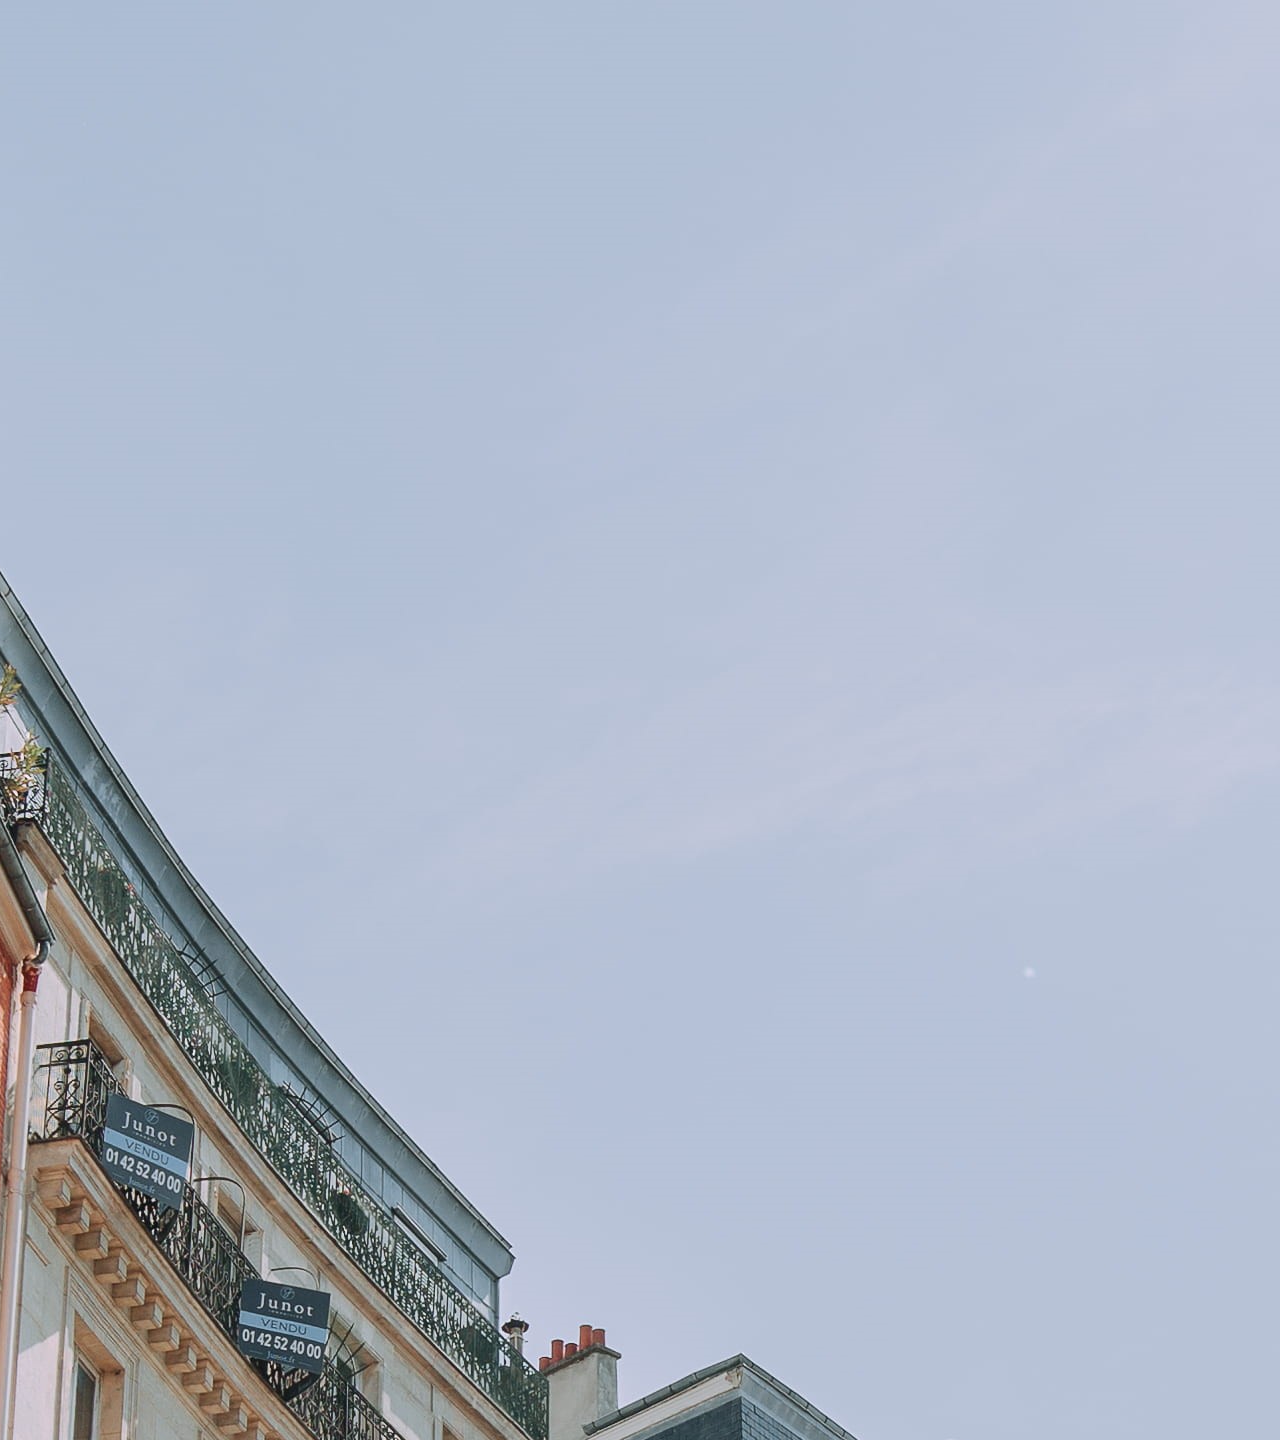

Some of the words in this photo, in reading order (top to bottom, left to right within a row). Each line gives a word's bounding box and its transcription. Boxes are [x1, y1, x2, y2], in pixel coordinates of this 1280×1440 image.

[122, 1112, 176, 1146] Junot
[125, 1138, 169, 1165] VENDU
[106, 1148, 118, 1165] 01
[120, 1155, 134, 1172] 42
[136, 1162, 150, 1179] 52
[151, 1169, 166, 1186] 40
[167, 1176, 181, 1193] 00
[257, 1292, 314, 1316] Junot
[261, 1318, 307, 1335] VENDU
[242, 1329, 255, 1343] 01
[257, 1333, 271, 1347] 42
[274, 1336, 288, 1351] 52
[290, 1340, 304, 1354] 40
[307, 1344, 321, 1359] 00
